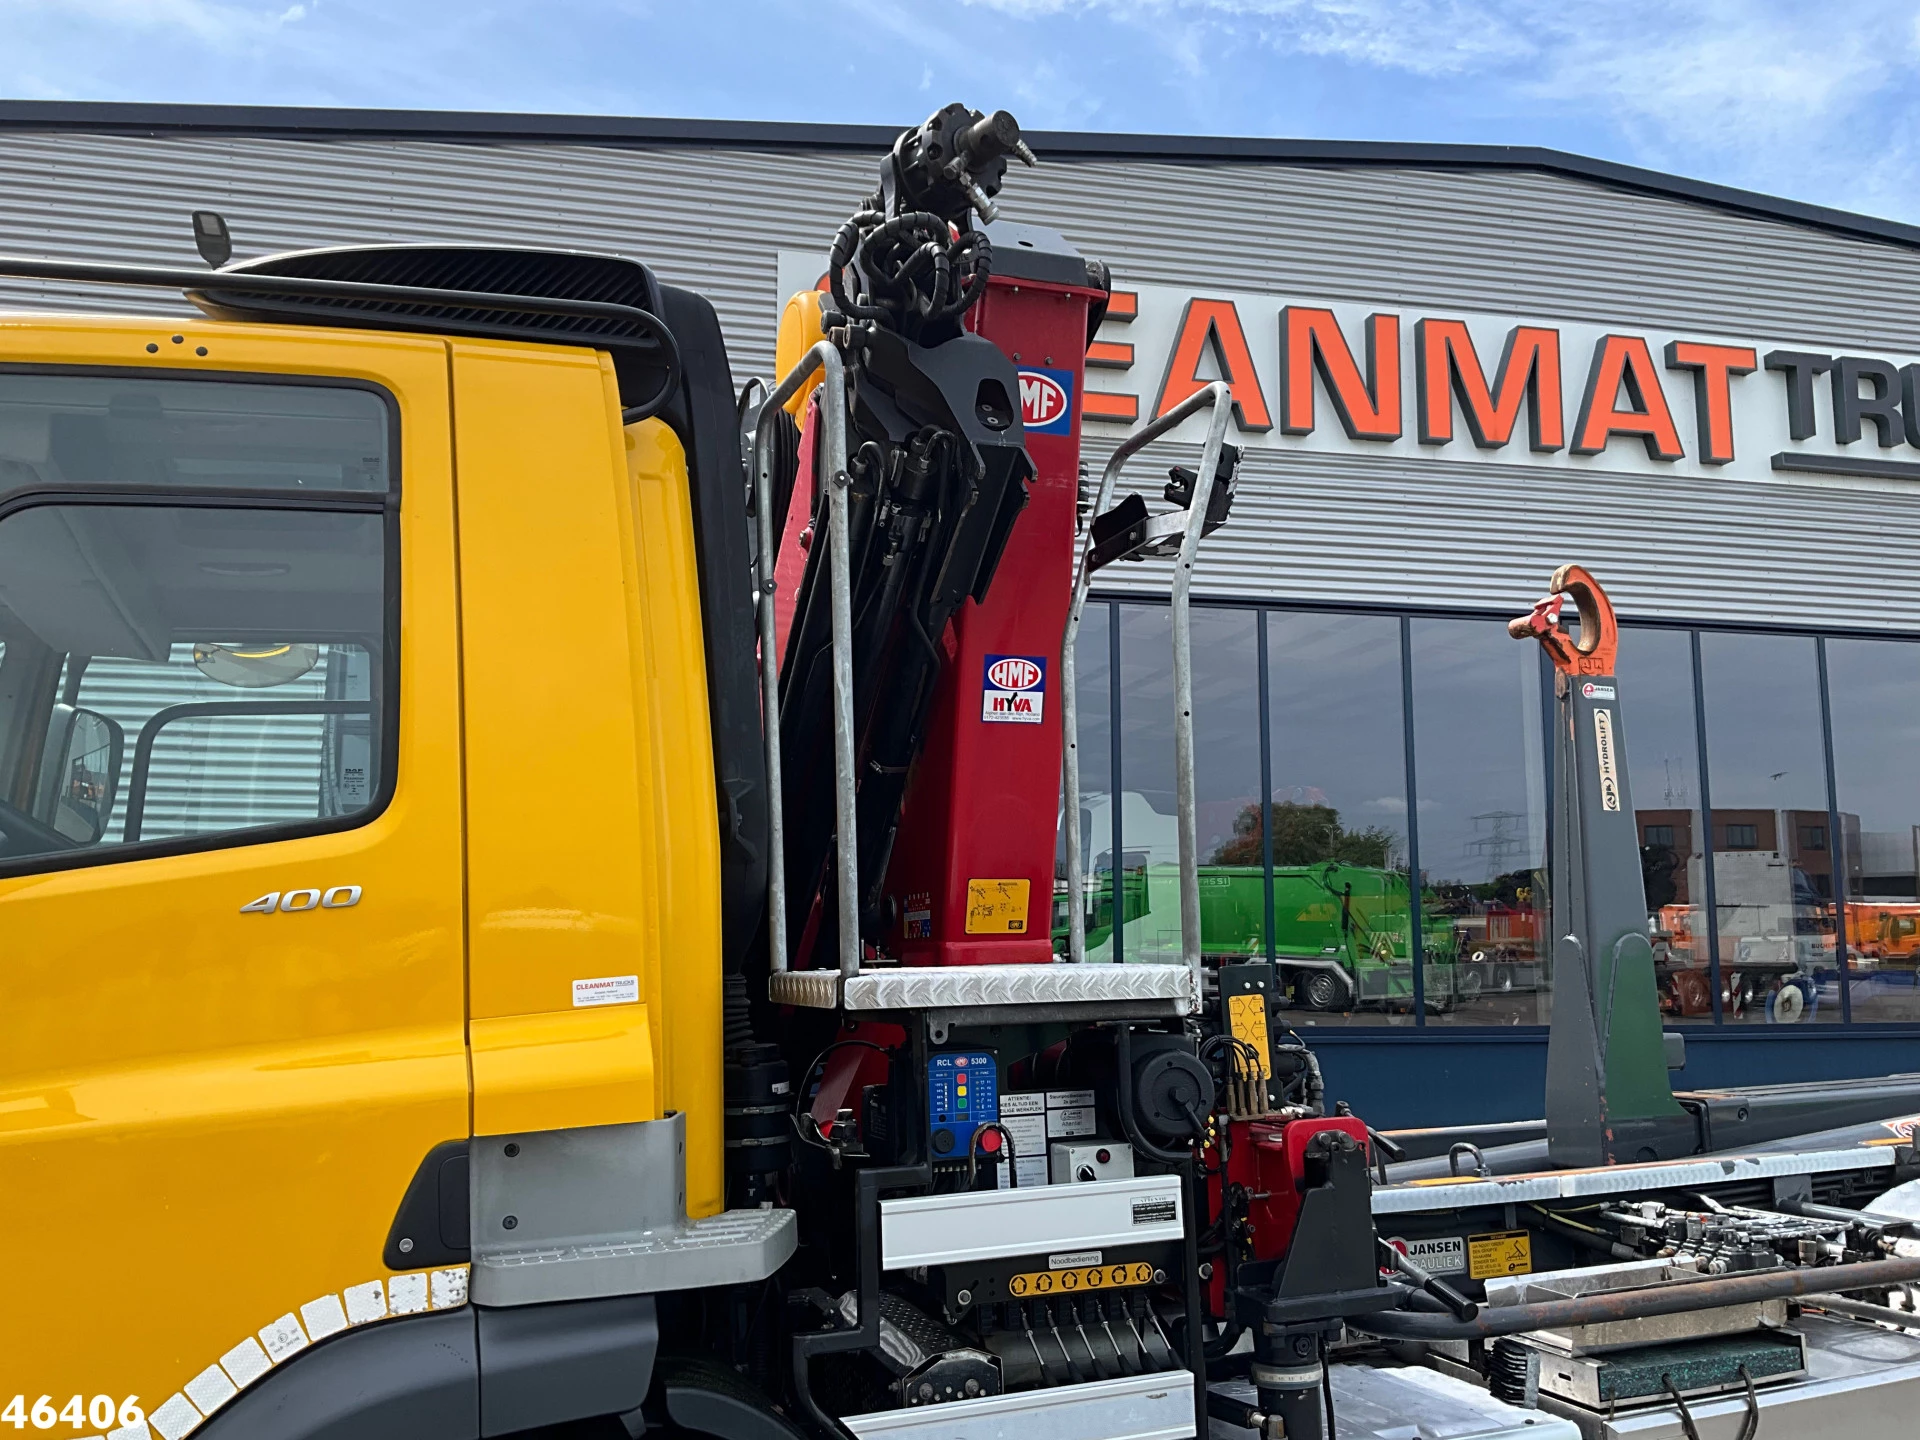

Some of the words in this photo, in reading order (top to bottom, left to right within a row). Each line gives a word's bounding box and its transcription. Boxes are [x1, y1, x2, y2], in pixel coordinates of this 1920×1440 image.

[815, 265, 1758, 465] EANMAT
[1018, 379, 1056, 419] MF
[994, 661, 1034, 687] HMF
[993, 692, 1032, 712] HYVA
[1599, 719, 1609, 773] HYDROLIFT
[240, 886, 362, 914] 400
[576, 982, 614, 990] CLEANMAT
[1410, 1240, 1461, 1256] JANSEN
[1051, 1255, 1099, 1265] Noodbediening
[1412, 1255, 1462, 1269] RAULIEK
